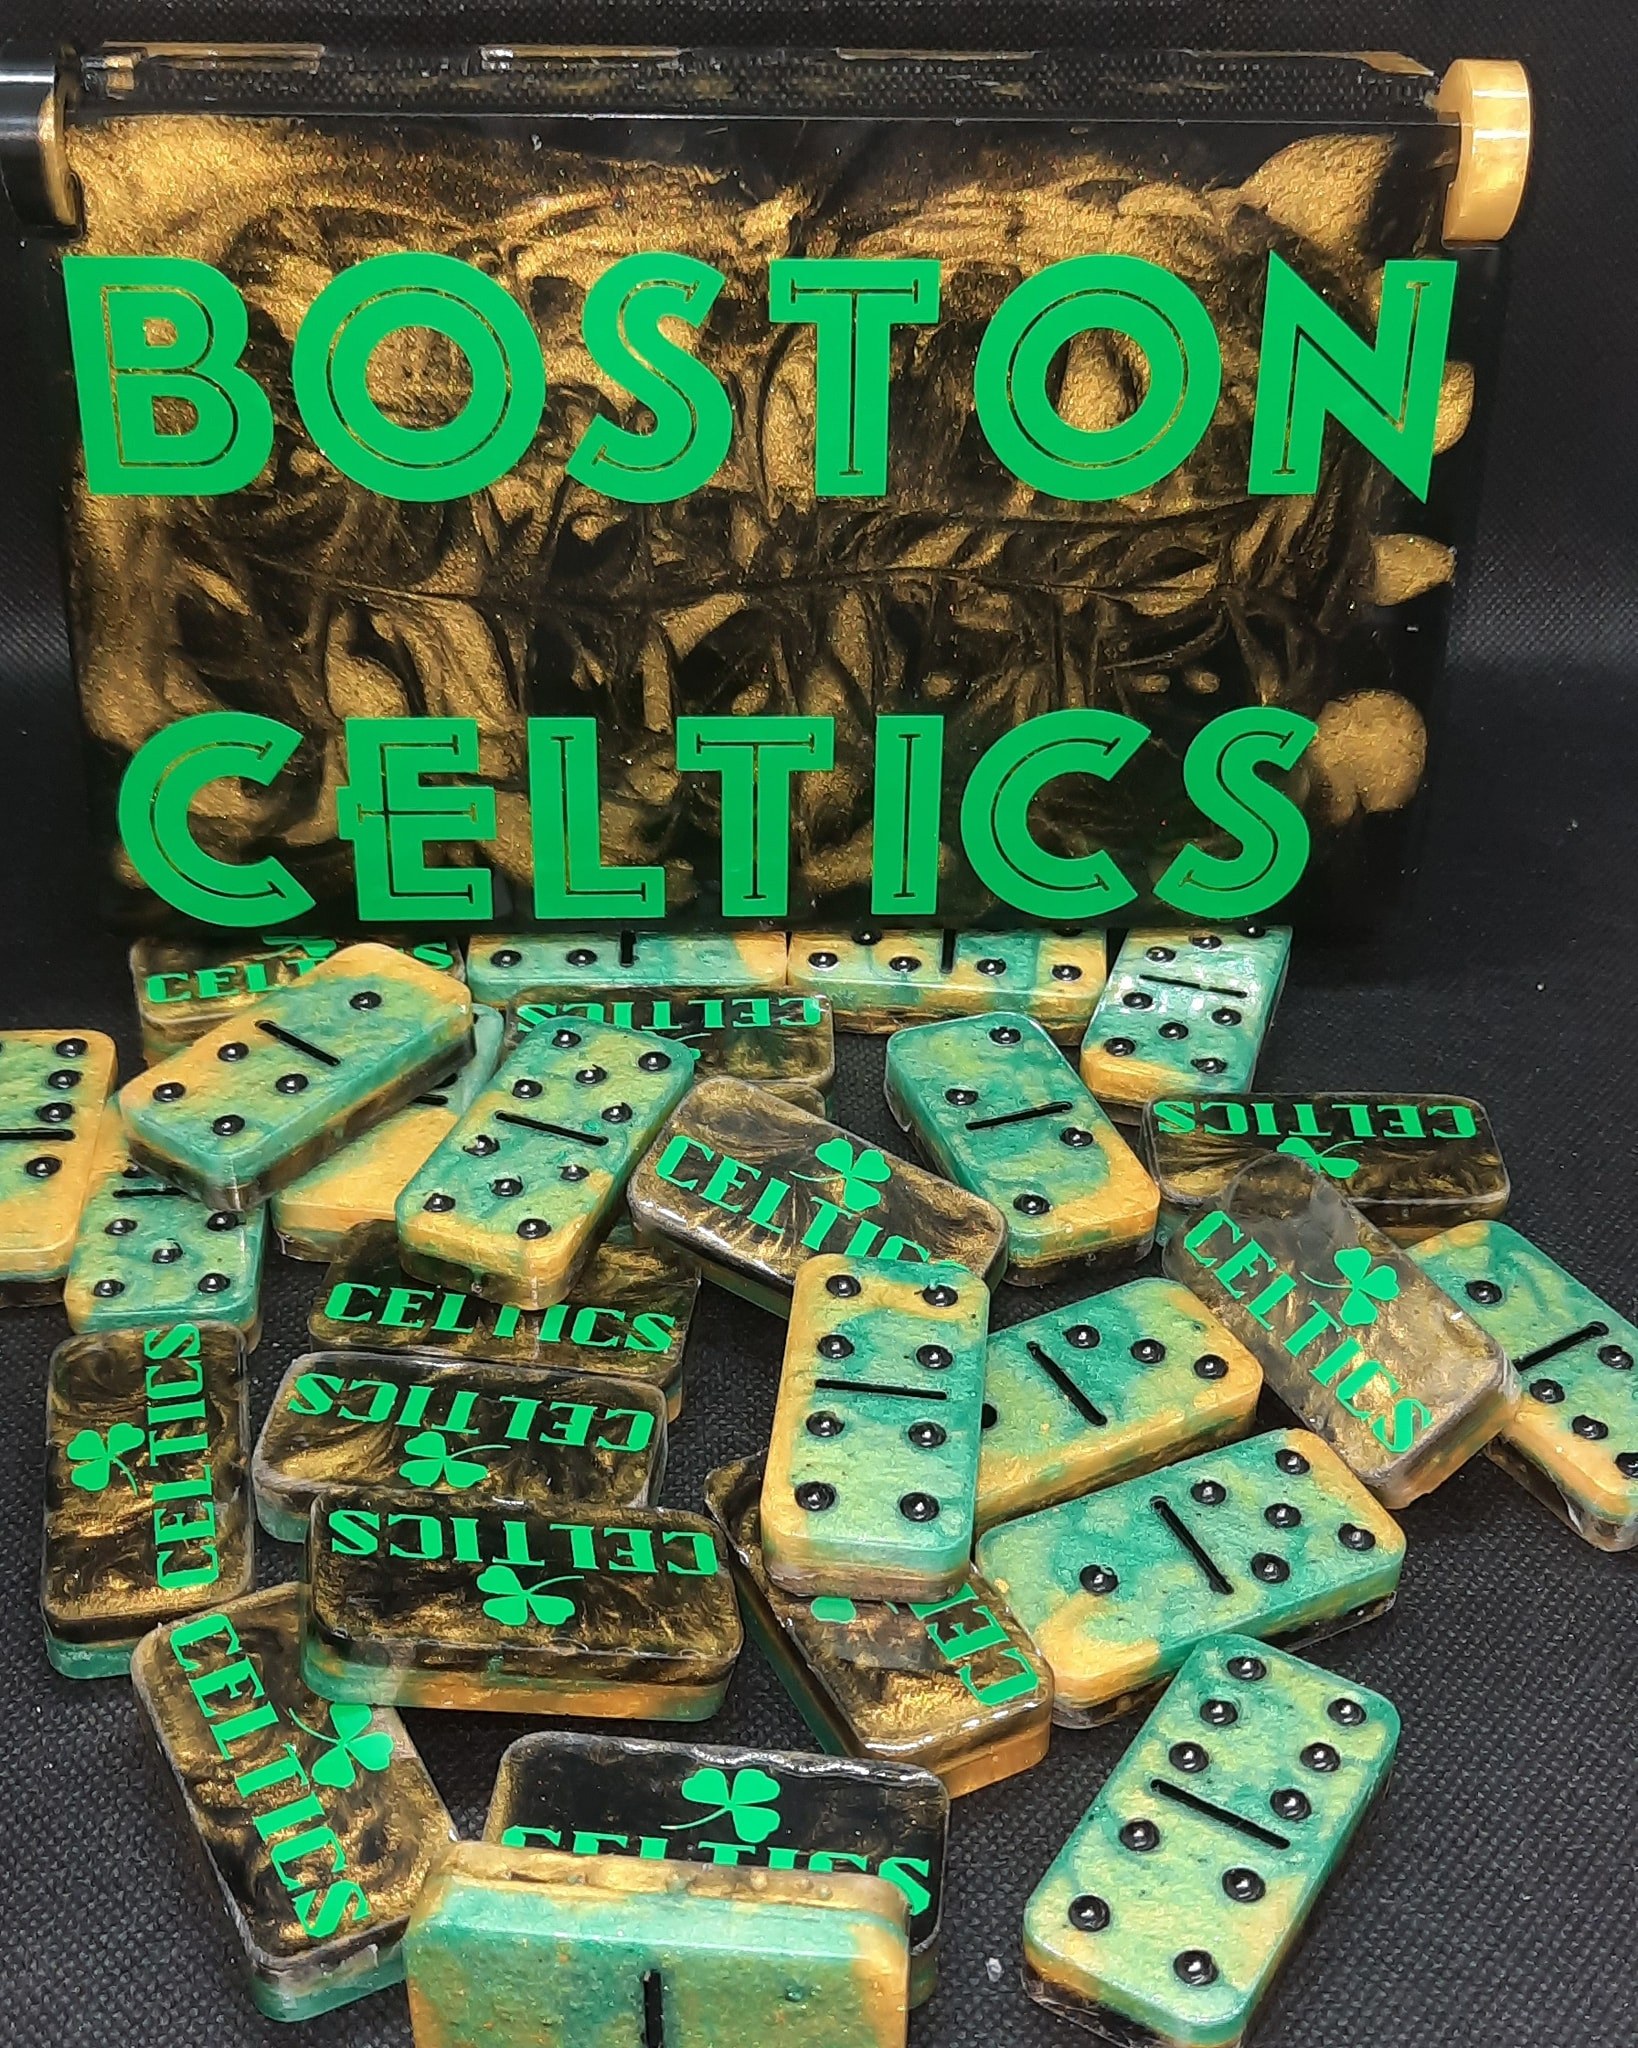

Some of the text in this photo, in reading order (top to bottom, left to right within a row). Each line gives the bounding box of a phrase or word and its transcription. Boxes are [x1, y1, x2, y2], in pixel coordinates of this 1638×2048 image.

[63, 251, 1458, 503] BOSTON
[117, 707, 1317, 927] CELTICS
[1155, 1101, 1479, 1138] CELTICS
[288, 1373, 656, 1453] CELTICS
[1184, 1209, 1433, 1453] CELTICS
[143, 1322, 220, 1590] CELTICS
[329, 1508, 719, 1577] CELTICS
[169, 1611, 370, 1938] CELTICS
